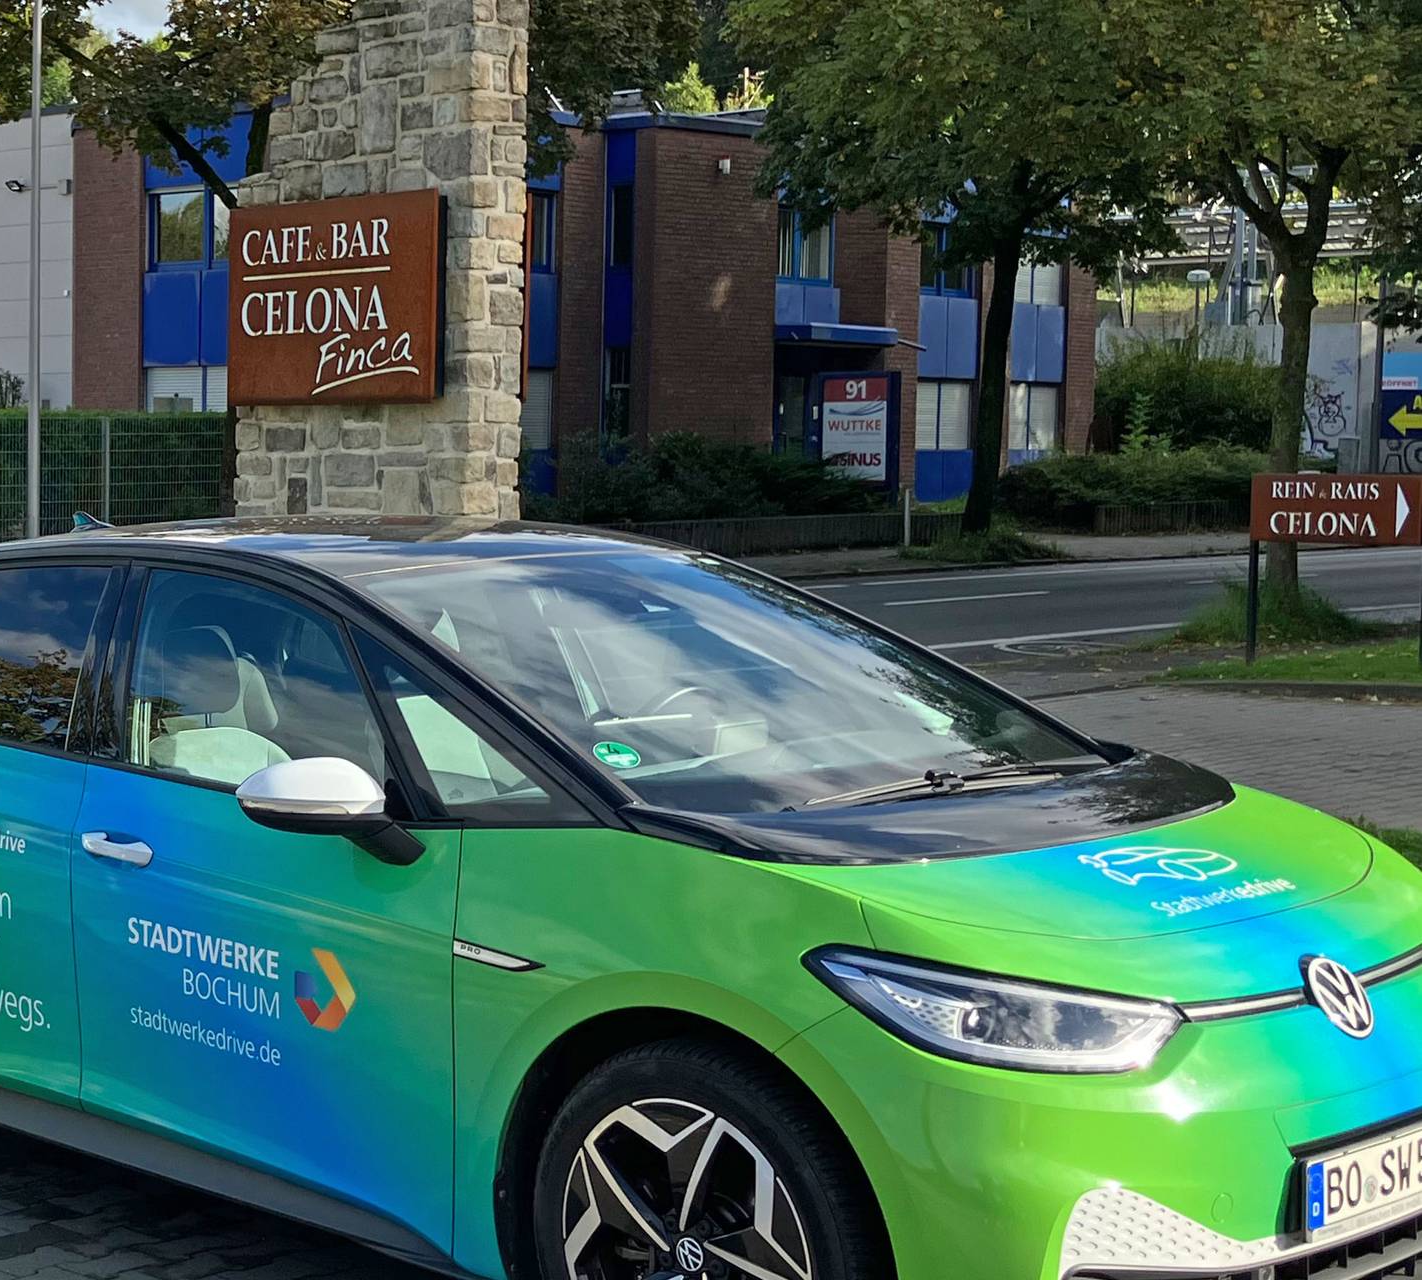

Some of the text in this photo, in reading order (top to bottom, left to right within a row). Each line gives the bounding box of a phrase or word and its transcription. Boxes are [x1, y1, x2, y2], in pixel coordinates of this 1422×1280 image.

[242, 217, 390, 267] CAFE & BAR
[241, 284, 389, 337] CELONA
[315, 332, 414, 384] Finca
[845, 380, 867, 399] 91
[828, 419, 881, 432] WUTTKE
[1272, 481, 1316, 498] REIN
[1330, 482, 1379, 500] RAUS
[1270, 511, 1377, 537] CELONA
[1150, 878, 1297, 917] Stadtwerkedrive
[128, 917, 280, 980] STADTWERKE
[460, 944, 481, 955] PRO
[182, 968, 280, 1020] BOCHUM
[130, 1005, 281, 1066] stadtwerkedrive.de
[1312, 1201, 1320, 1217] D
[1327, 1160, 1362, 1216] BO
